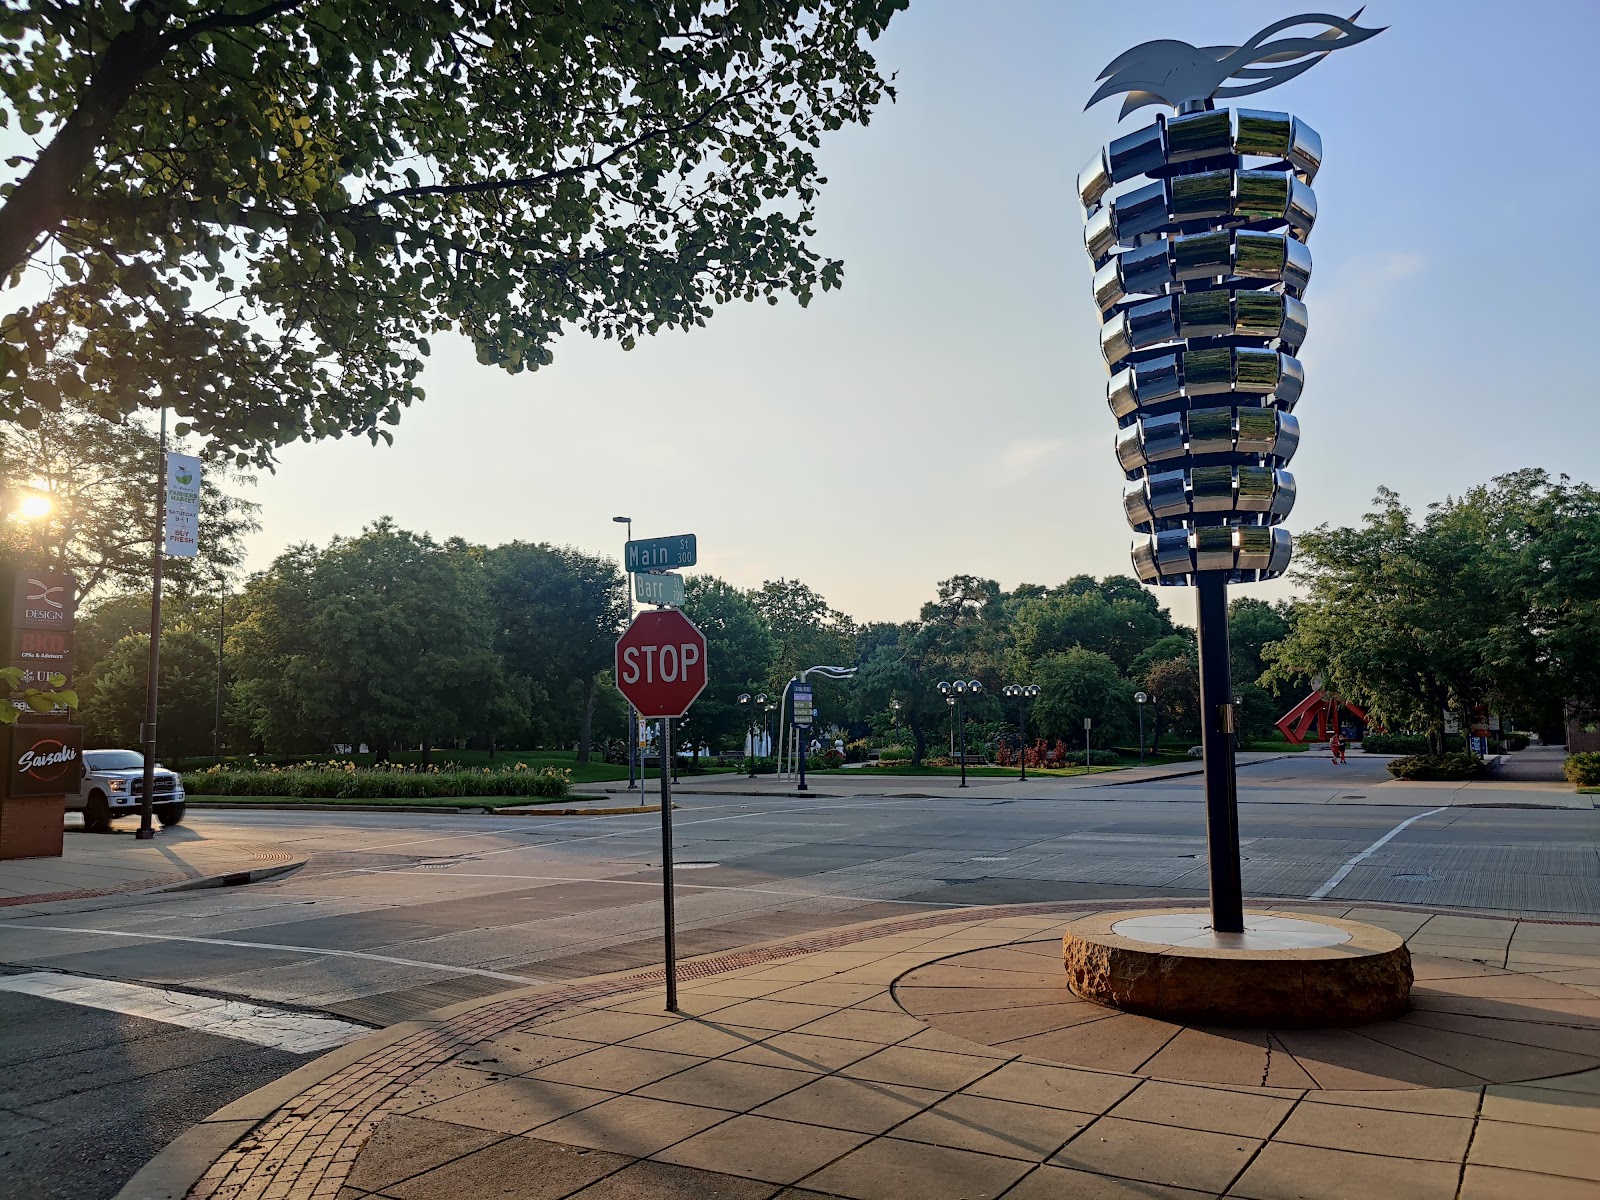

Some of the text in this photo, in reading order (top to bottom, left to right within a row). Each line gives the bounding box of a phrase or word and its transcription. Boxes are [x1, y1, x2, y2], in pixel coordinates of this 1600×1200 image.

[170, 536, 194, 544] FRESH
[629, 538, 689, 567] Main St
[677, 551, 692, 563] 300
[637, 575, 681, 598] Barr St
[25, 609, 63, 620] DESIGN
[622, 643, 699, 684] STOP
[18, 745, 77, 773] Saisaki
